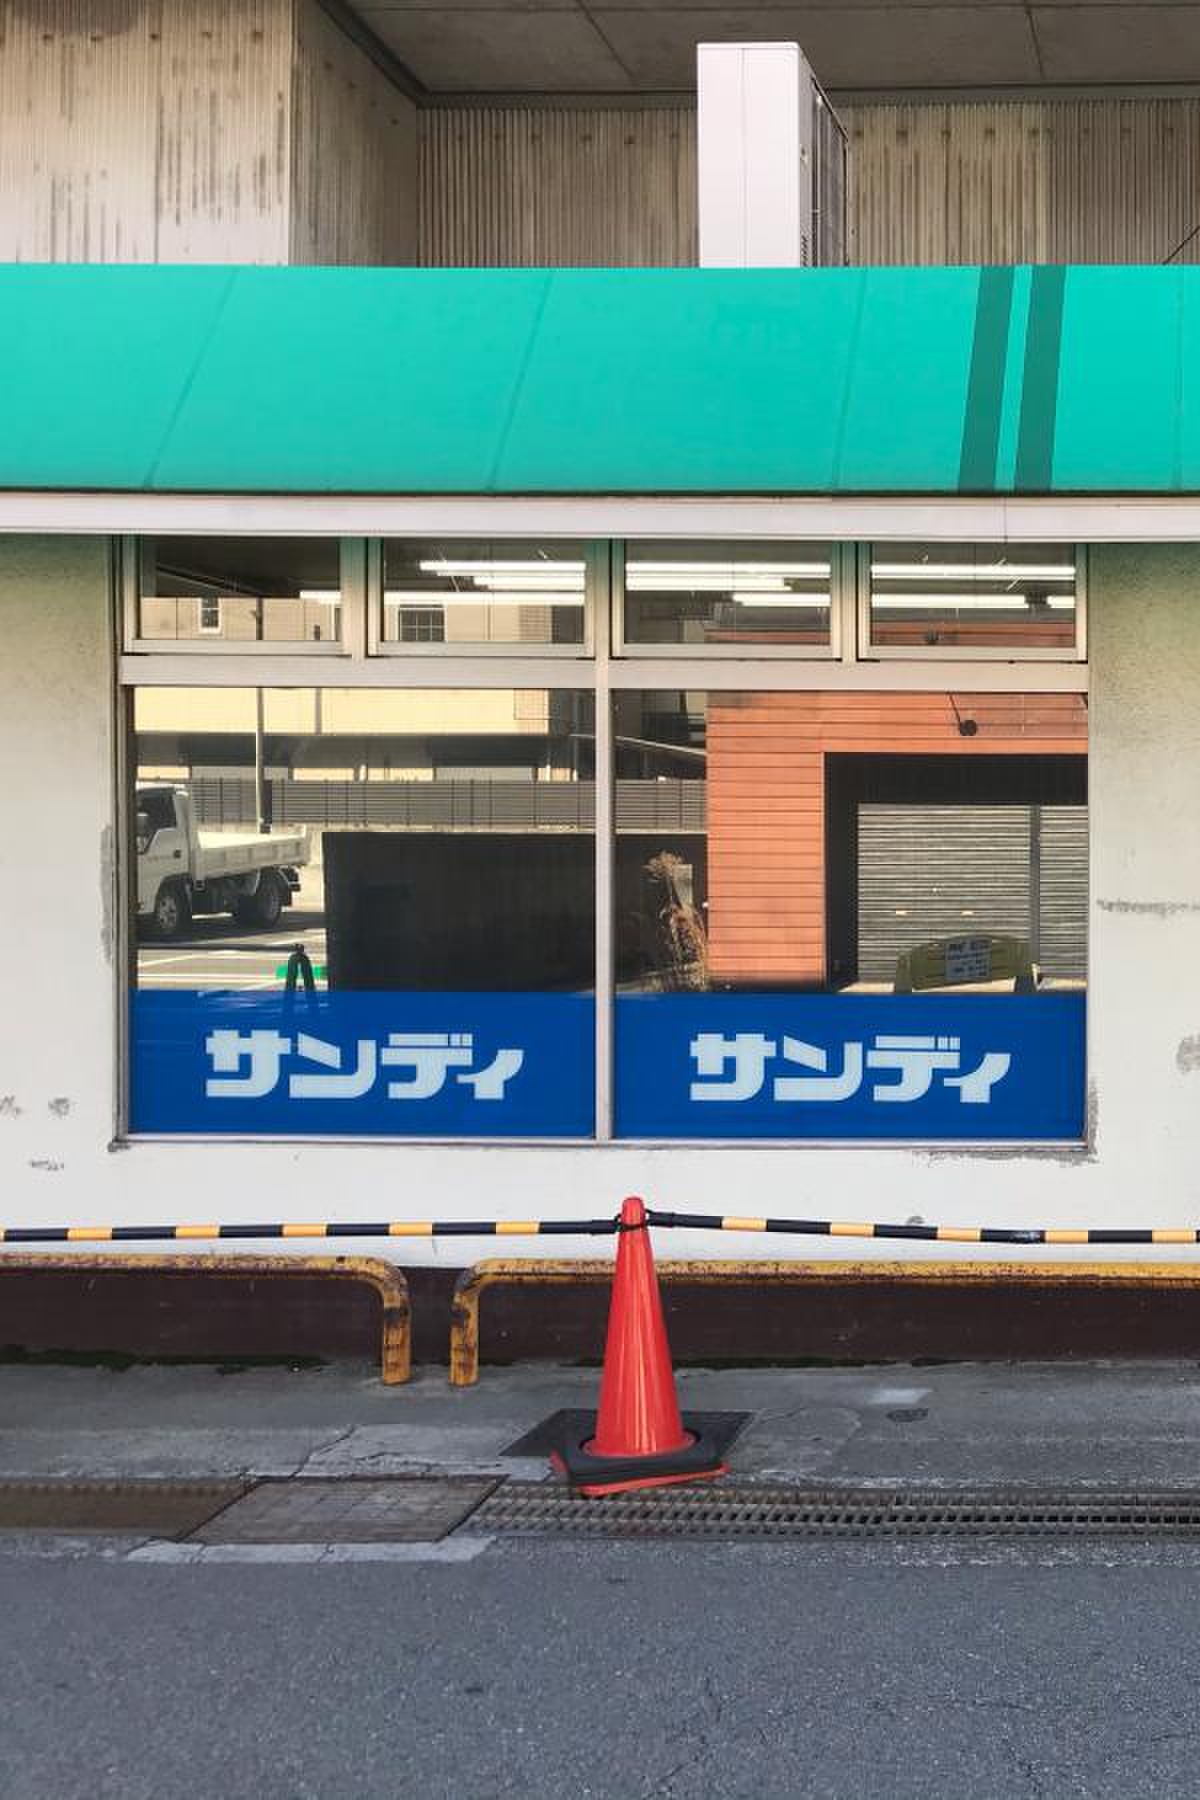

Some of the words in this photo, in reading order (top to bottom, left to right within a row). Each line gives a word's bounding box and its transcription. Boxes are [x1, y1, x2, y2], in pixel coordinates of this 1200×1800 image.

[206, 1030, 523, 1099] サンディ
[690, 1033, 1011, 1103] サンディ
